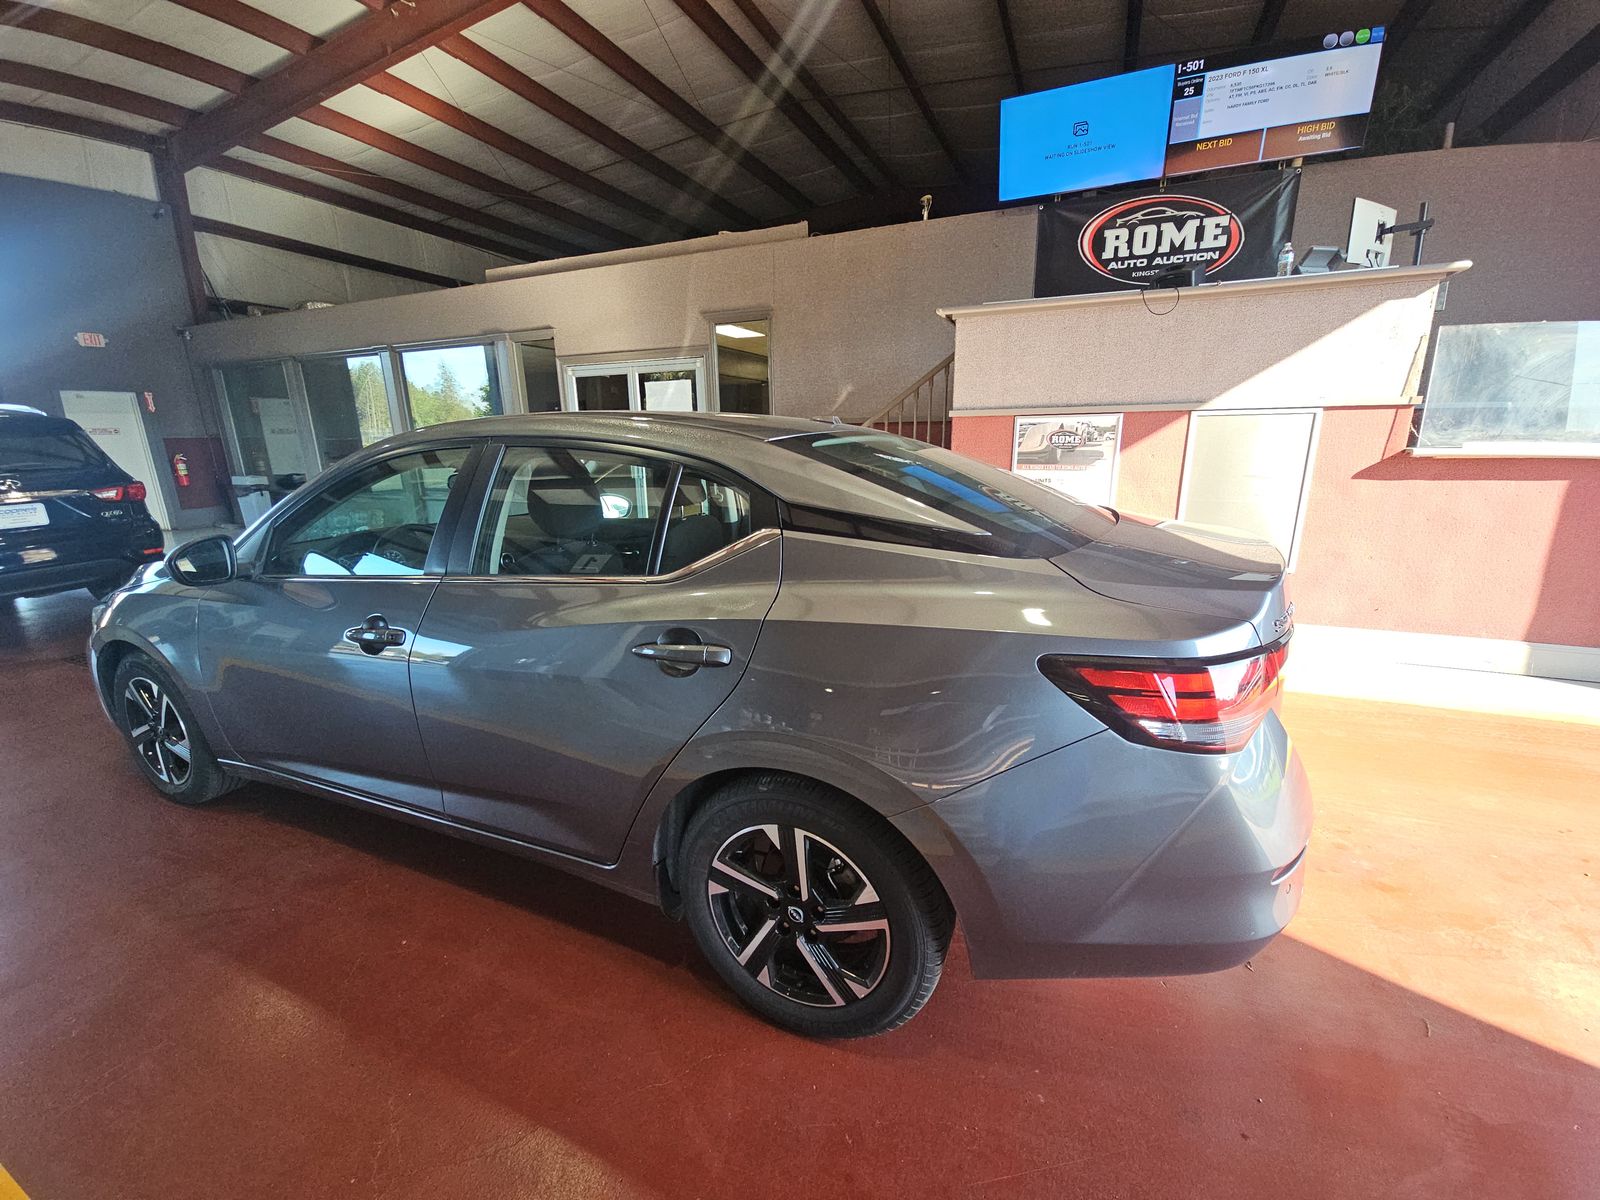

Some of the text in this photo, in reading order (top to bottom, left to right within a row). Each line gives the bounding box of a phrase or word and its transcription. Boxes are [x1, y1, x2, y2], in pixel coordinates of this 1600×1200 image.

[1224, 71, 1241, 80] FORD
[1184, 86, 1194, 96] 25
[1297, 121, 1336, 135] HIGH BID
[1298, 133, 1321, 142] Awaiting
[1196, 138, 1233, 151] NEXT BID
[1101, 214, 1231, 260] ROME
[1107, 250, 1220, 270] AUTO AUCTION
[82, 334, 102, 346] EXIT
